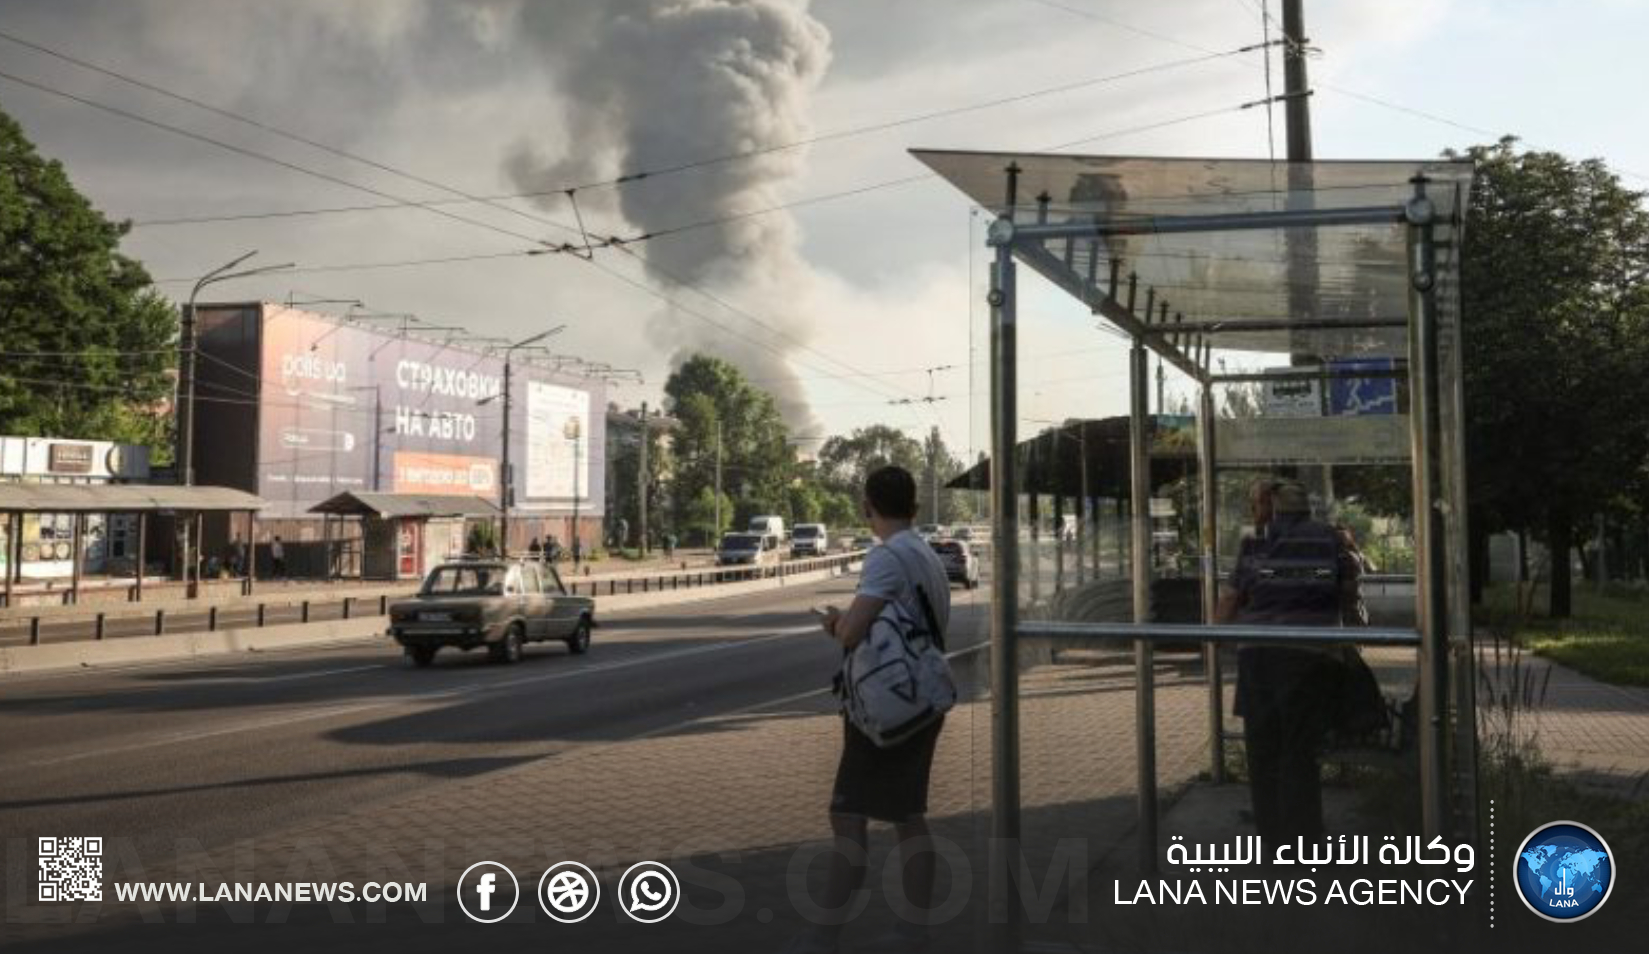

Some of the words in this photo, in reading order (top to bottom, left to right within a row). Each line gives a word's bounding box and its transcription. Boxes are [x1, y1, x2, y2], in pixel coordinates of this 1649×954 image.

[396, 360, 500, 399] СТРАХОВКИ
[395, 405, 423, 436] НА
[429, 409, 475, 441] АВТО
